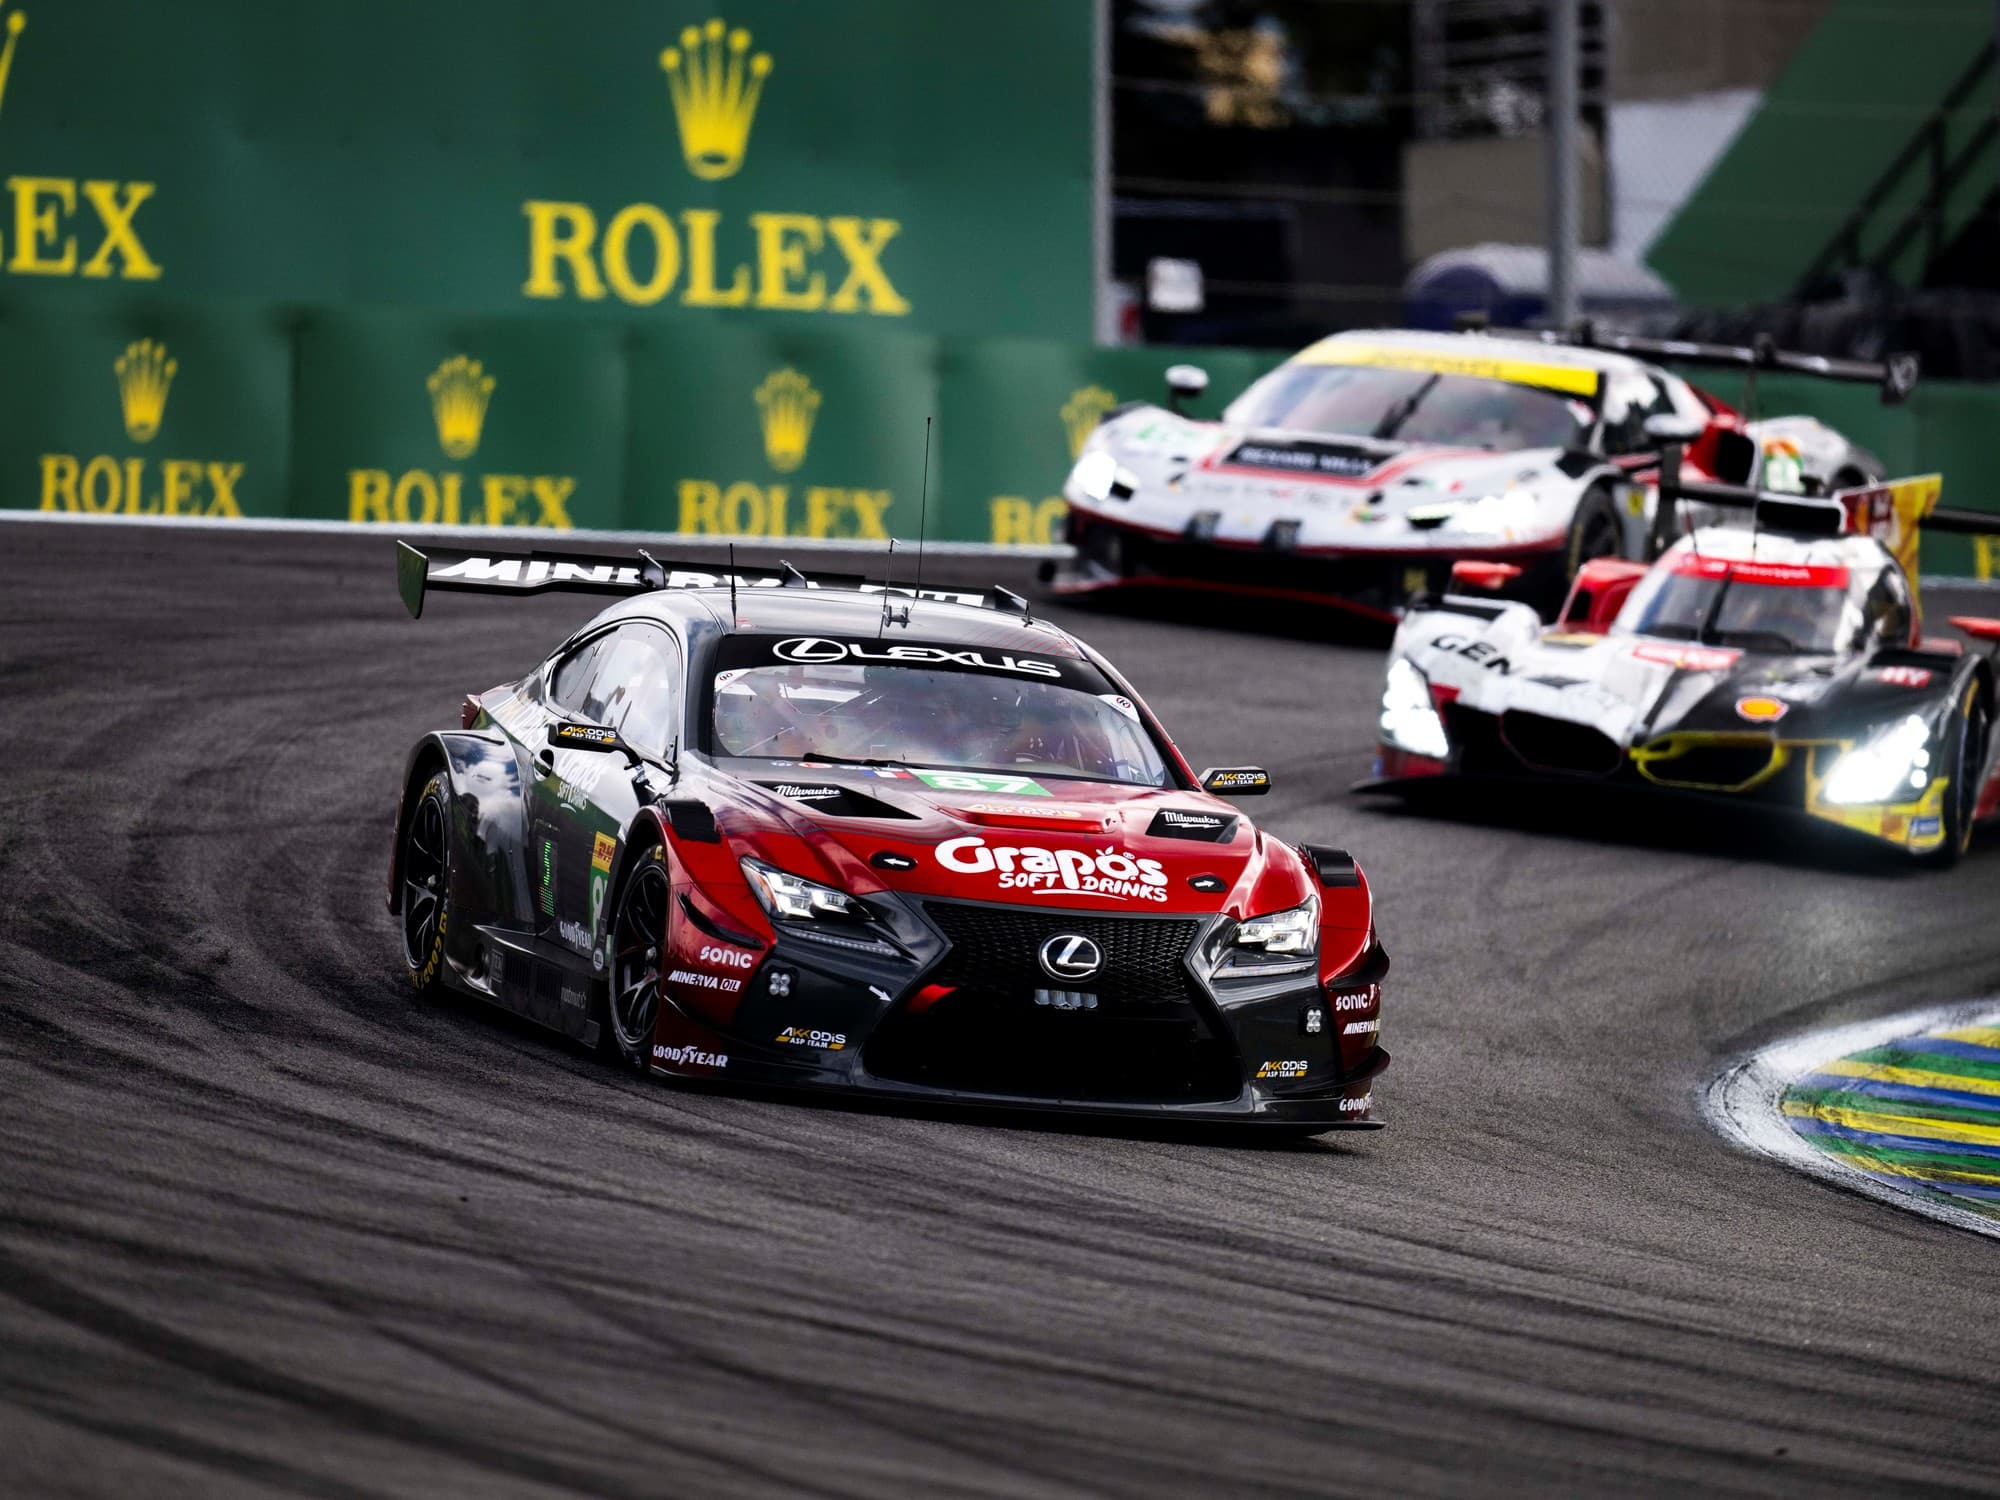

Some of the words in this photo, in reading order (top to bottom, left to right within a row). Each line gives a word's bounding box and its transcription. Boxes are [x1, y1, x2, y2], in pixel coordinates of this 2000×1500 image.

[0, 175, 162, 280] EX
[522, 198, 911, 316] ROLEX
[38, 454, 246, 518] ROLEX
[347, 468, 578, 530] ROLEX
[676, 478, 893, 540] ROLEX
[848, 643, 1061, 678] LEXUS
[774, 784, 841, 796] Milwaukee
[931, 774, 1032, 794] 87
[1160, 811, 1221, 825] Milwaukee
[998, 872, 1060, 888] SOFT
[1082, 875, 1168, 902] DRINKS
[668, 970, 718, 990] MINERVA
[721, 977, 740, 991] OIL
[653, 1046, 728, 1068] GOODYEAR
[807, 1040, 828, 1048] TEAM
